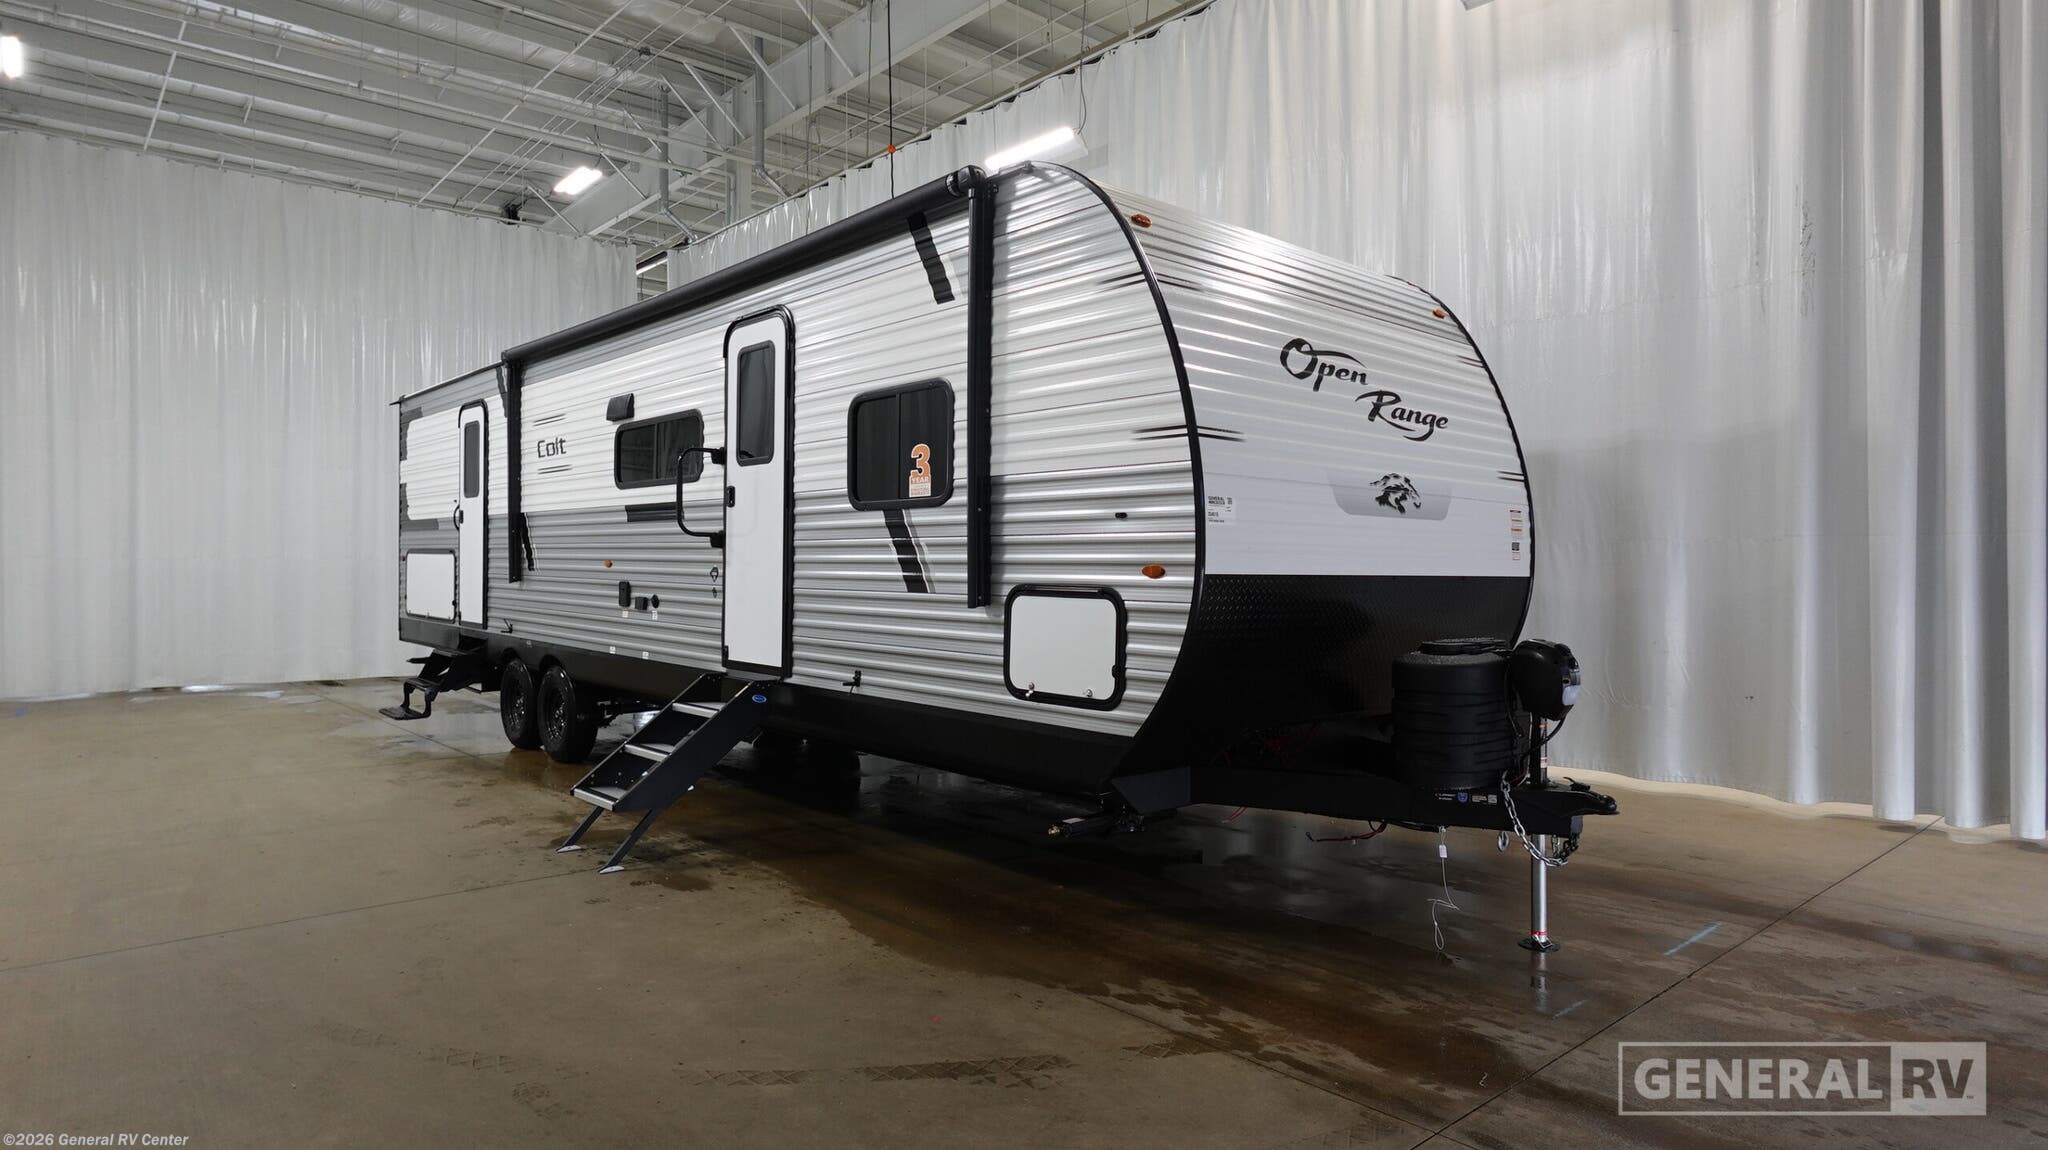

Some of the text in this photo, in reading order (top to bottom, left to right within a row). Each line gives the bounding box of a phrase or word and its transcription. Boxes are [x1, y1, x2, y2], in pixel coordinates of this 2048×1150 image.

[1280, 338, 1368, 392] Open
[1355, 390, 1449, 441] Range
[537, 437, 567, 458] Colt
[911, 444, 930, 478] 3
